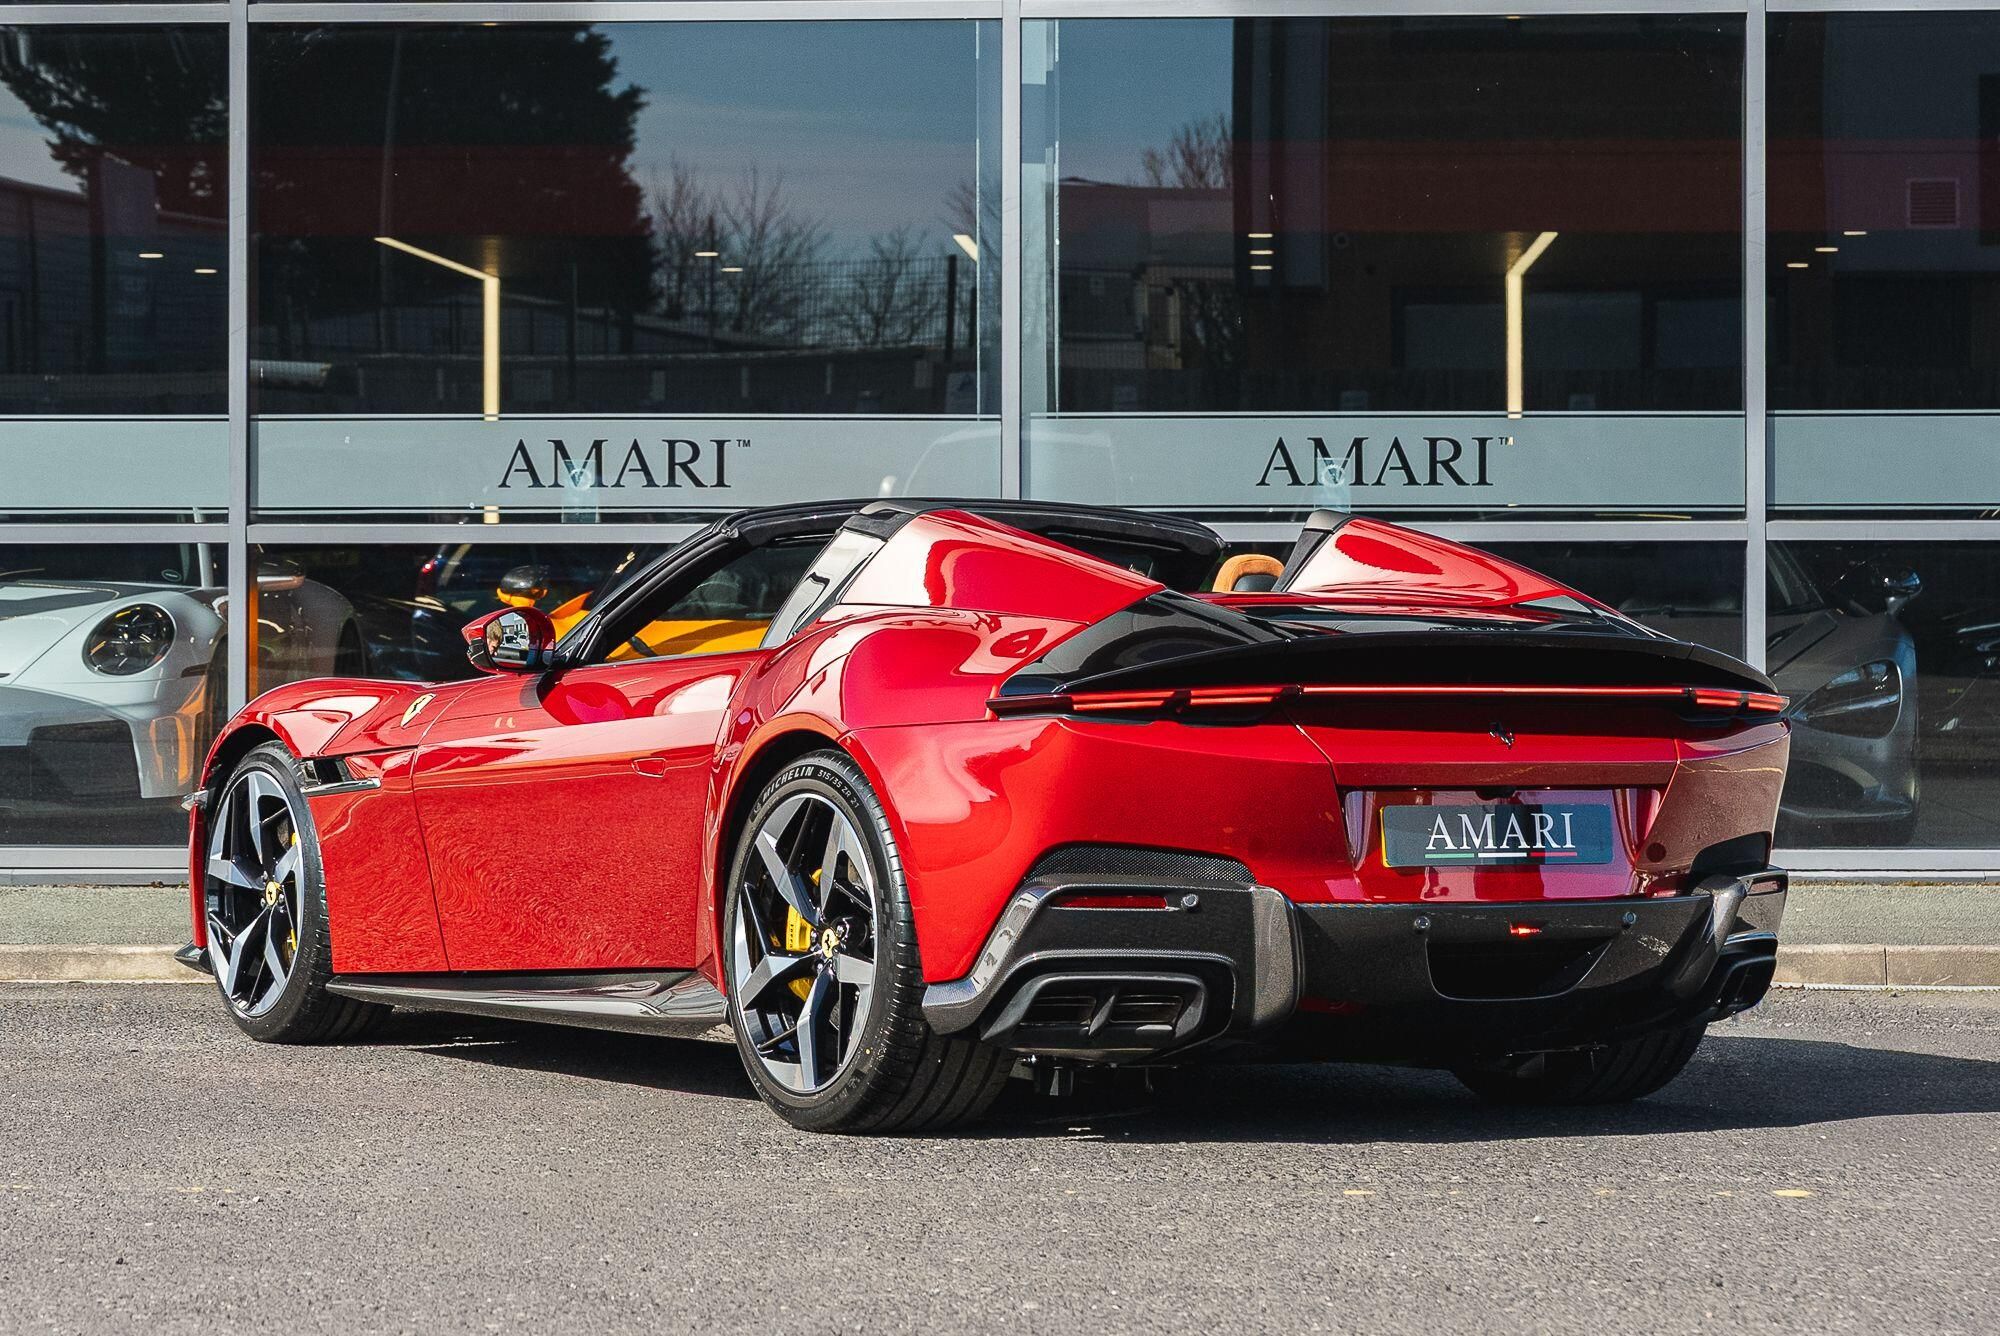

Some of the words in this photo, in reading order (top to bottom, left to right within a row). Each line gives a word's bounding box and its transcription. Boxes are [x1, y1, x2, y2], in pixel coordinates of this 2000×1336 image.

[498, 438, 732, 489] AMARI
[1255, 436, 1494, 487] AMARI
[762, 766, 815, 803] MICHELIN
[1425, 812, 1577, 850] AMARI
